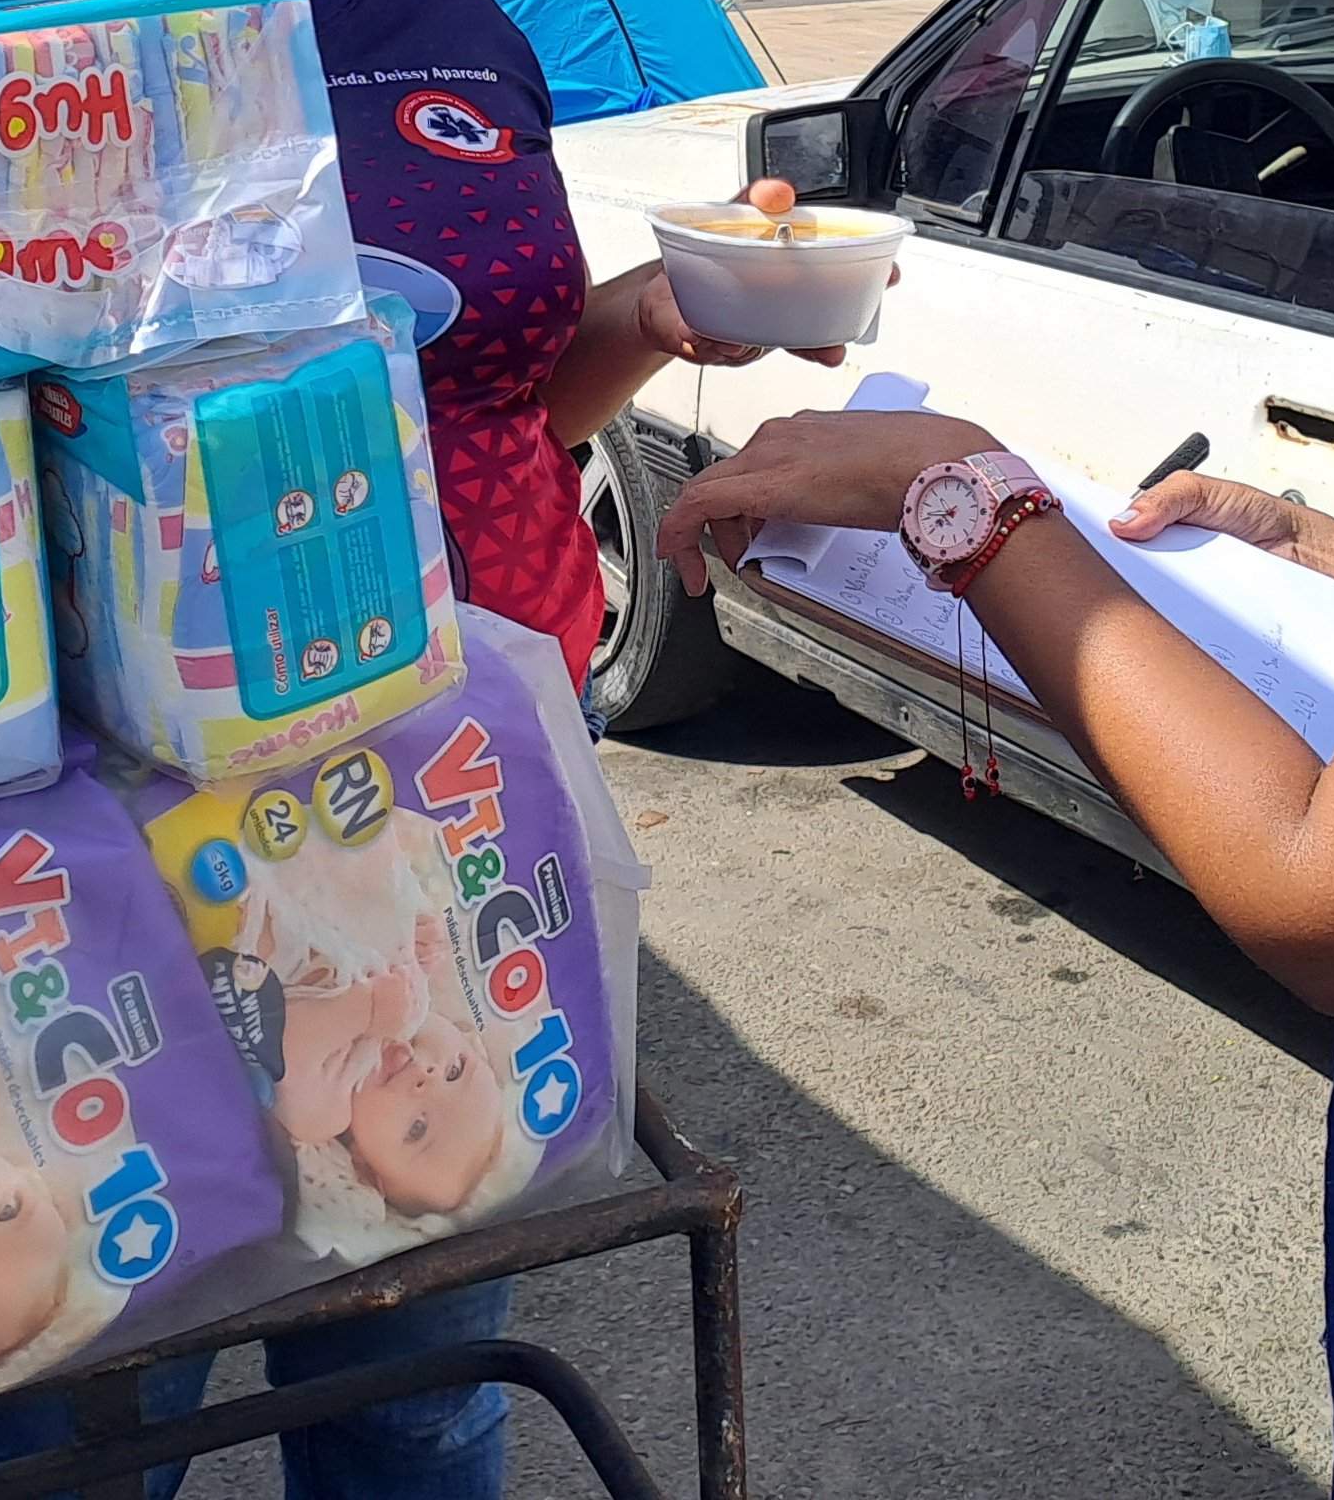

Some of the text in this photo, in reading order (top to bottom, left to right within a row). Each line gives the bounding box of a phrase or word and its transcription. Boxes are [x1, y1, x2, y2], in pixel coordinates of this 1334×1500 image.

[374, 68, 428, 83] Deissy
[432, 67, 498, 82] Aparcedo
[267, 607, 289, 693] Cómo utilizar
[264, 800, 298, 844] 24
[320, 750, 388, 840] RN
[541, 861, 564, 928] Premium
[119, 980, 152, 1053] Premium
[240, 991, 264, 1045] WITH
[454, 955, 486, 1032] desechables
[8, 1083, 47, 1168] desechables
